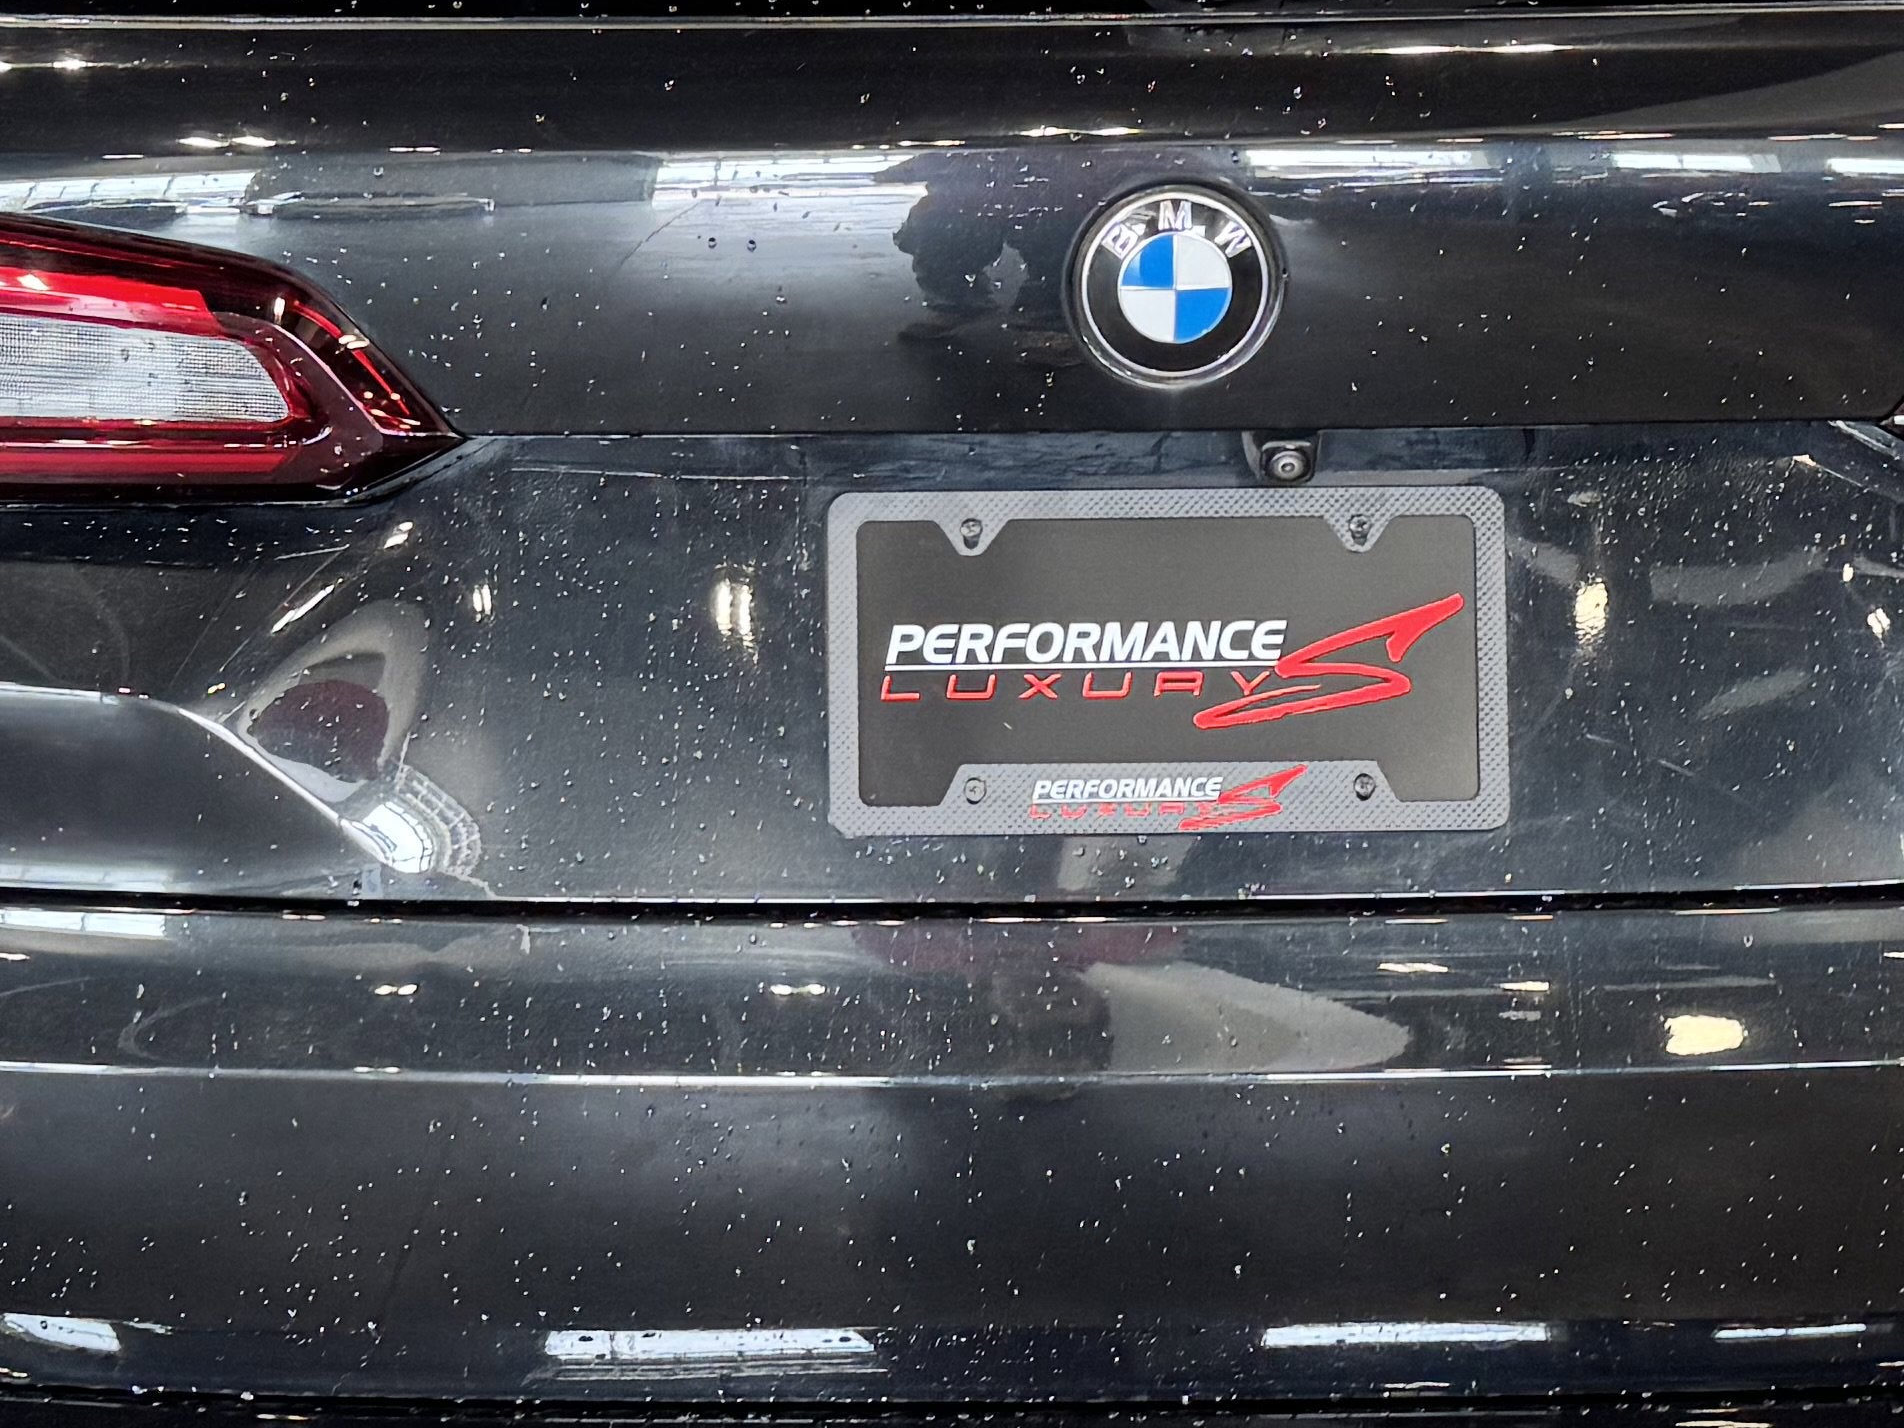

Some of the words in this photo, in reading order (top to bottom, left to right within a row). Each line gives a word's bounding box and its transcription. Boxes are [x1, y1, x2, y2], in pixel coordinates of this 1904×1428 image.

[1100, 199, 1252, 260] BMW
[885, 619, 1288, 664] PERFORMANCE
[881, 670, 1270, 702] LUXURY
[1032, 775, 1224, 800] PERFORMANCE
